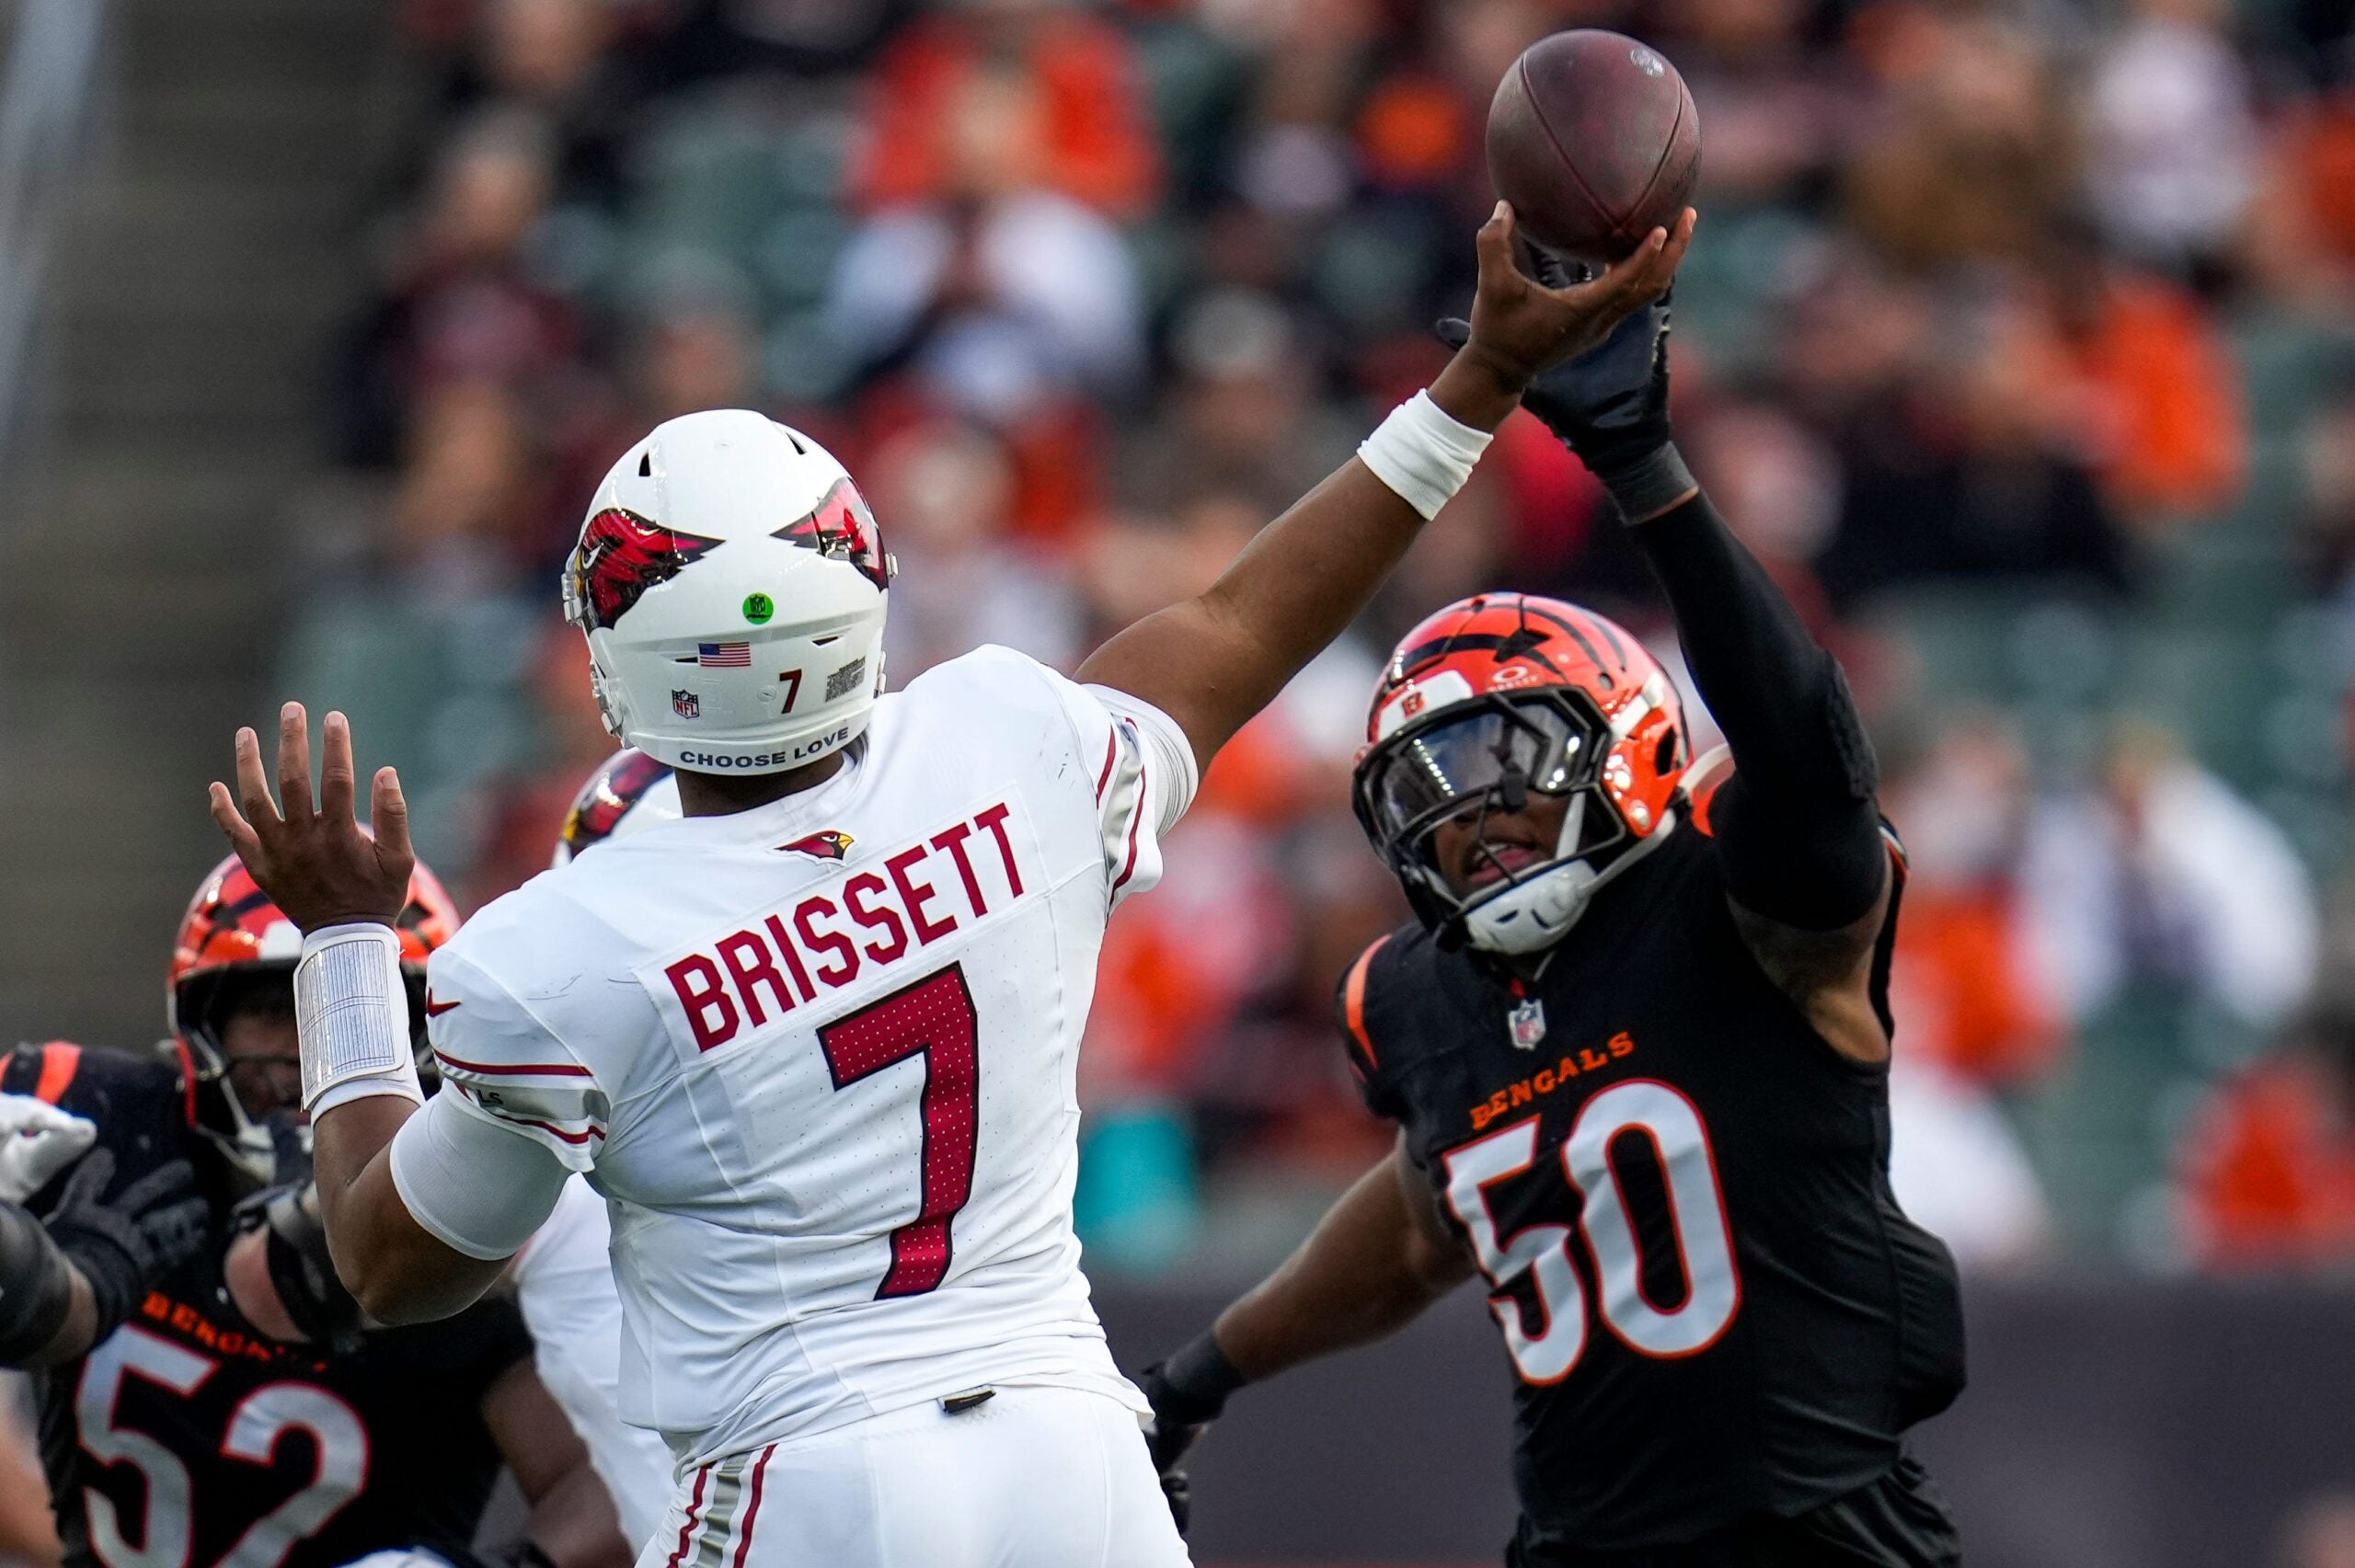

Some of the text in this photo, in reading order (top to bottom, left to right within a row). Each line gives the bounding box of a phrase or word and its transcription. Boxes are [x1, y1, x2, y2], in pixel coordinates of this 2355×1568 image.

[675, 700, 698, 716] NFL
[679, 727, 849, 768] CHOOSE LOVE
[779, 669, 803, 714] 7
[664, 801, 1024, 1053] BRISSETT
[815, 959, 980, 1301] 7
[1469, 1031, 1636, 1131] BENGALS
[1442, 1077, 1743, 1388] 50
[75, 1322, 371, 1568] 52
